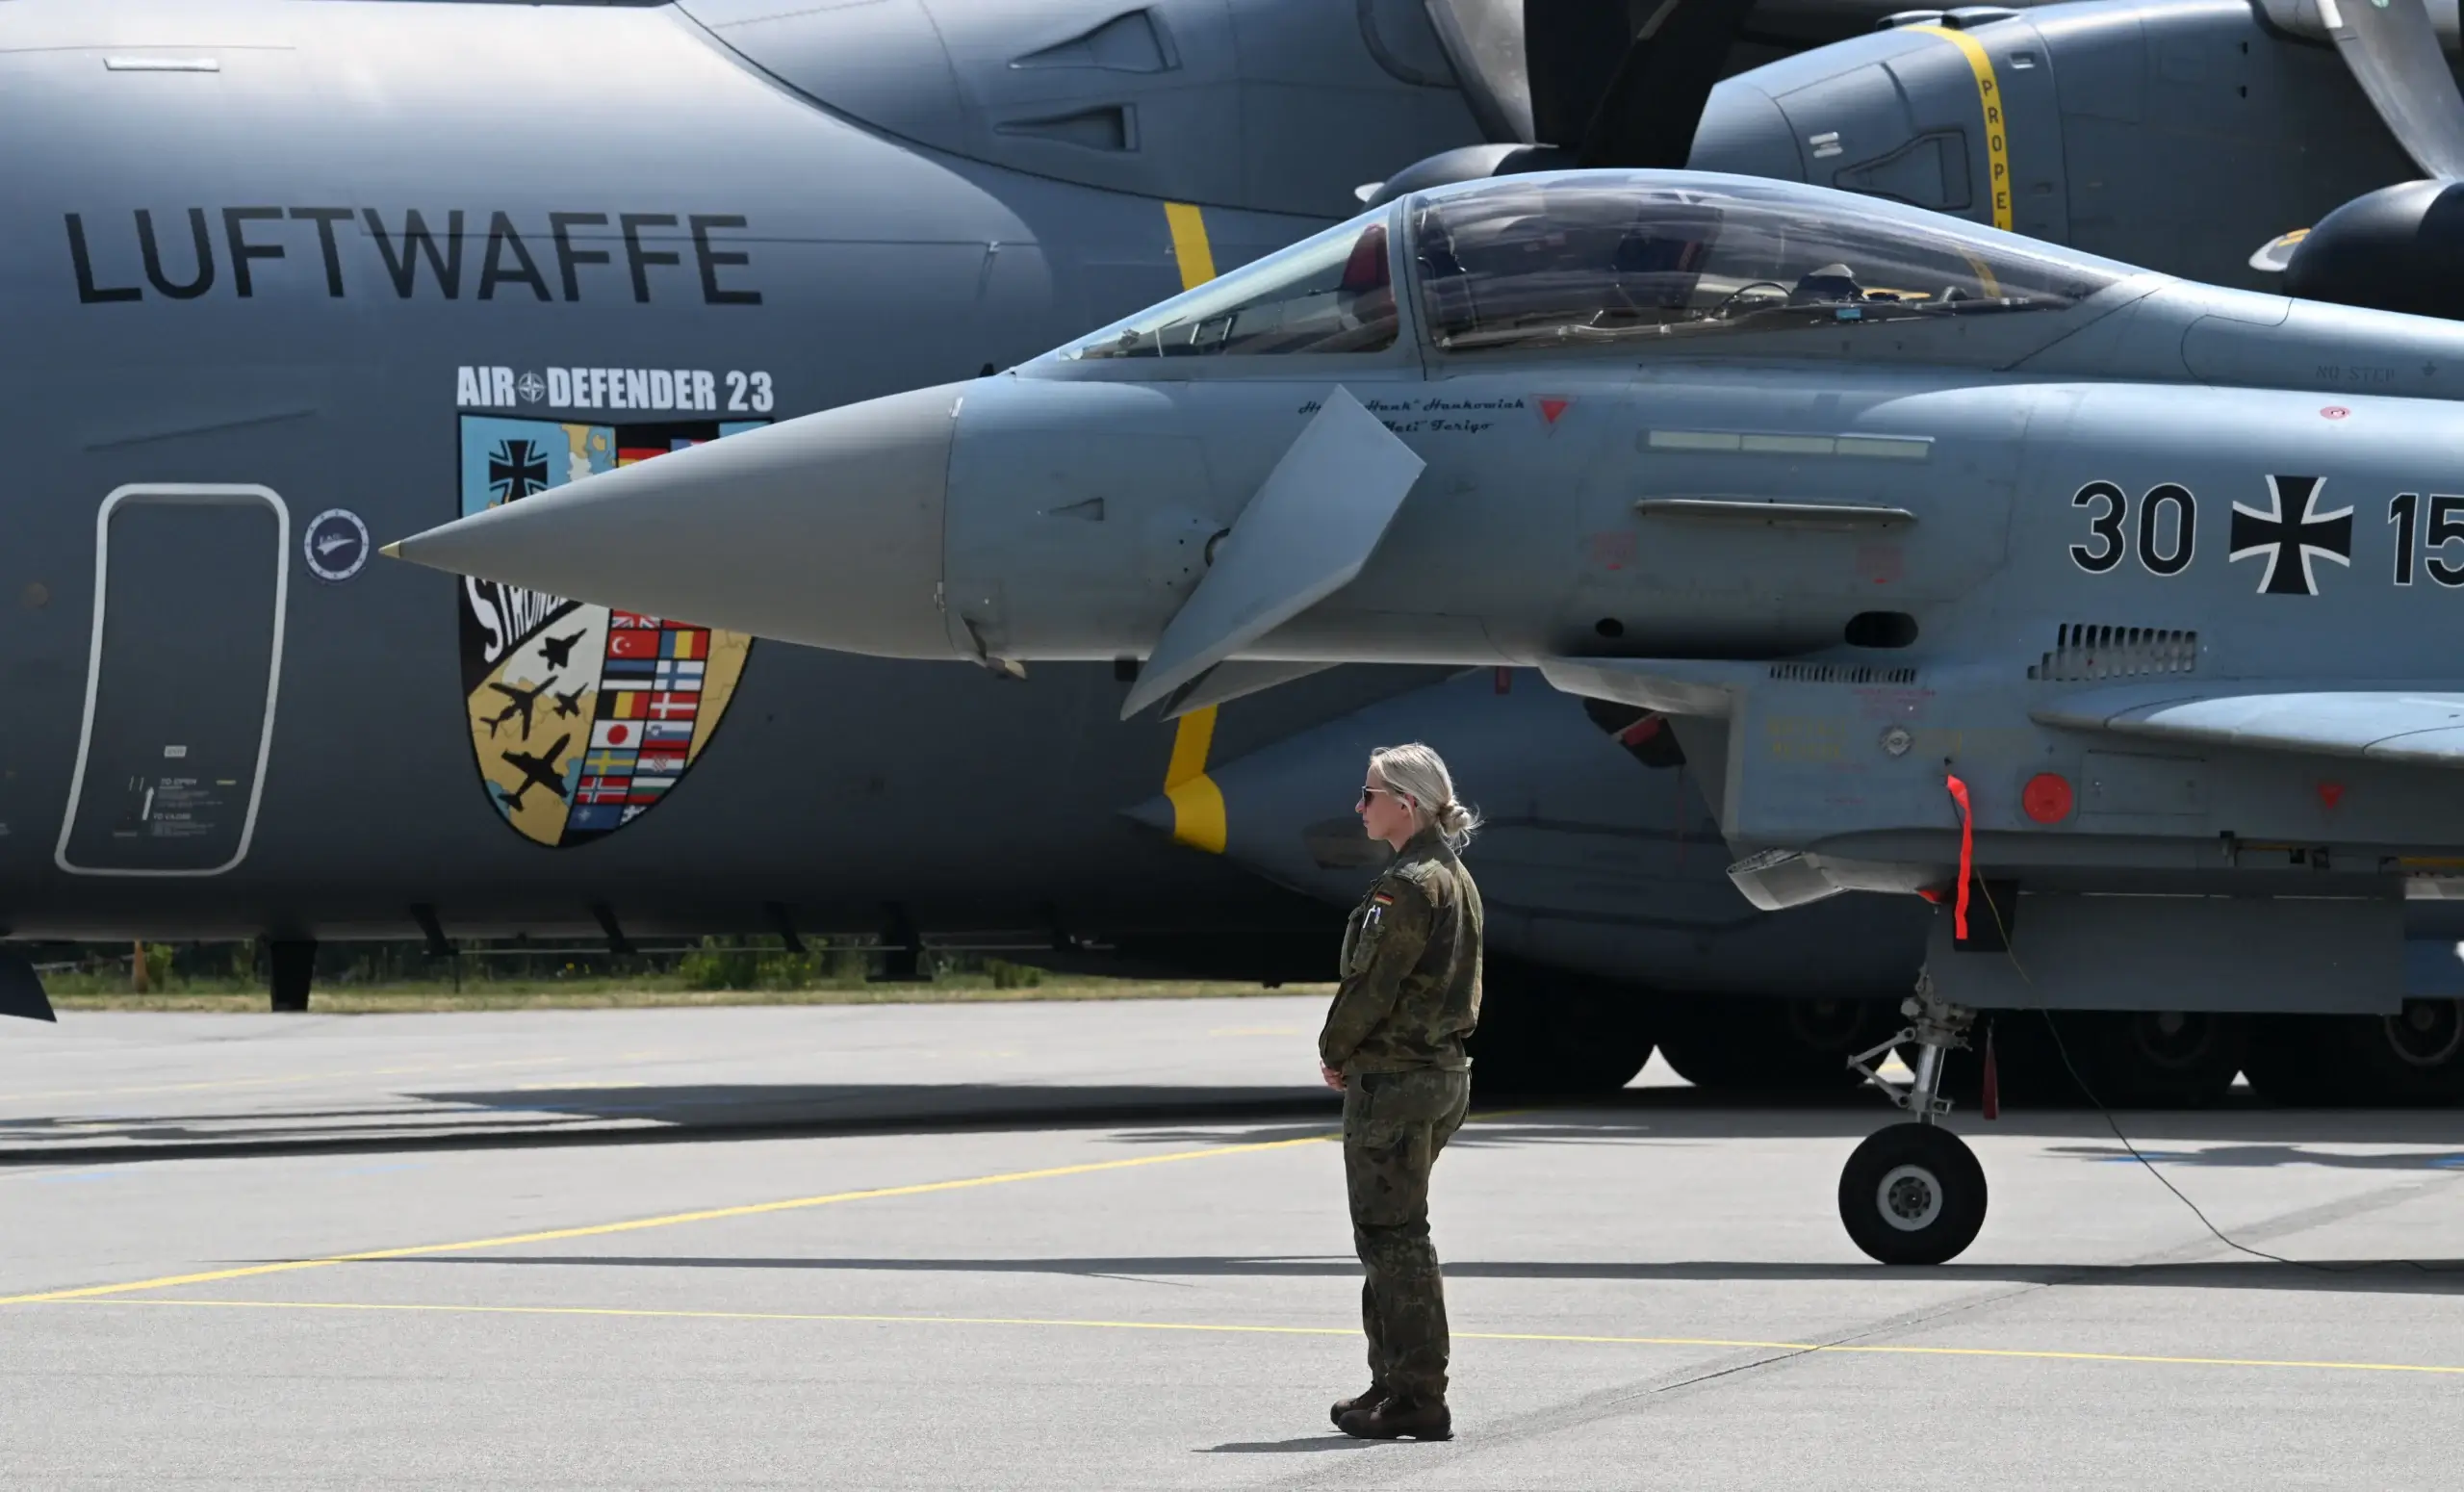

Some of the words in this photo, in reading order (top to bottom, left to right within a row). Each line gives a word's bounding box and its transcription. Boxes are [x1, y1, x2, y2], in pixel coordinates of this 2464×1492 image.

[1982, 80, 2008, 229] PROPE
[64, 206, 763, 306] LUFTWAFFE
[456, 366, 516, 406] AIR
[547, 367, 716, 411] DEFENDER
[725, 371, 775, 412] 23
[2068, 479, 2197, 578] 30
[2387, 492, 2464, 589] 15
